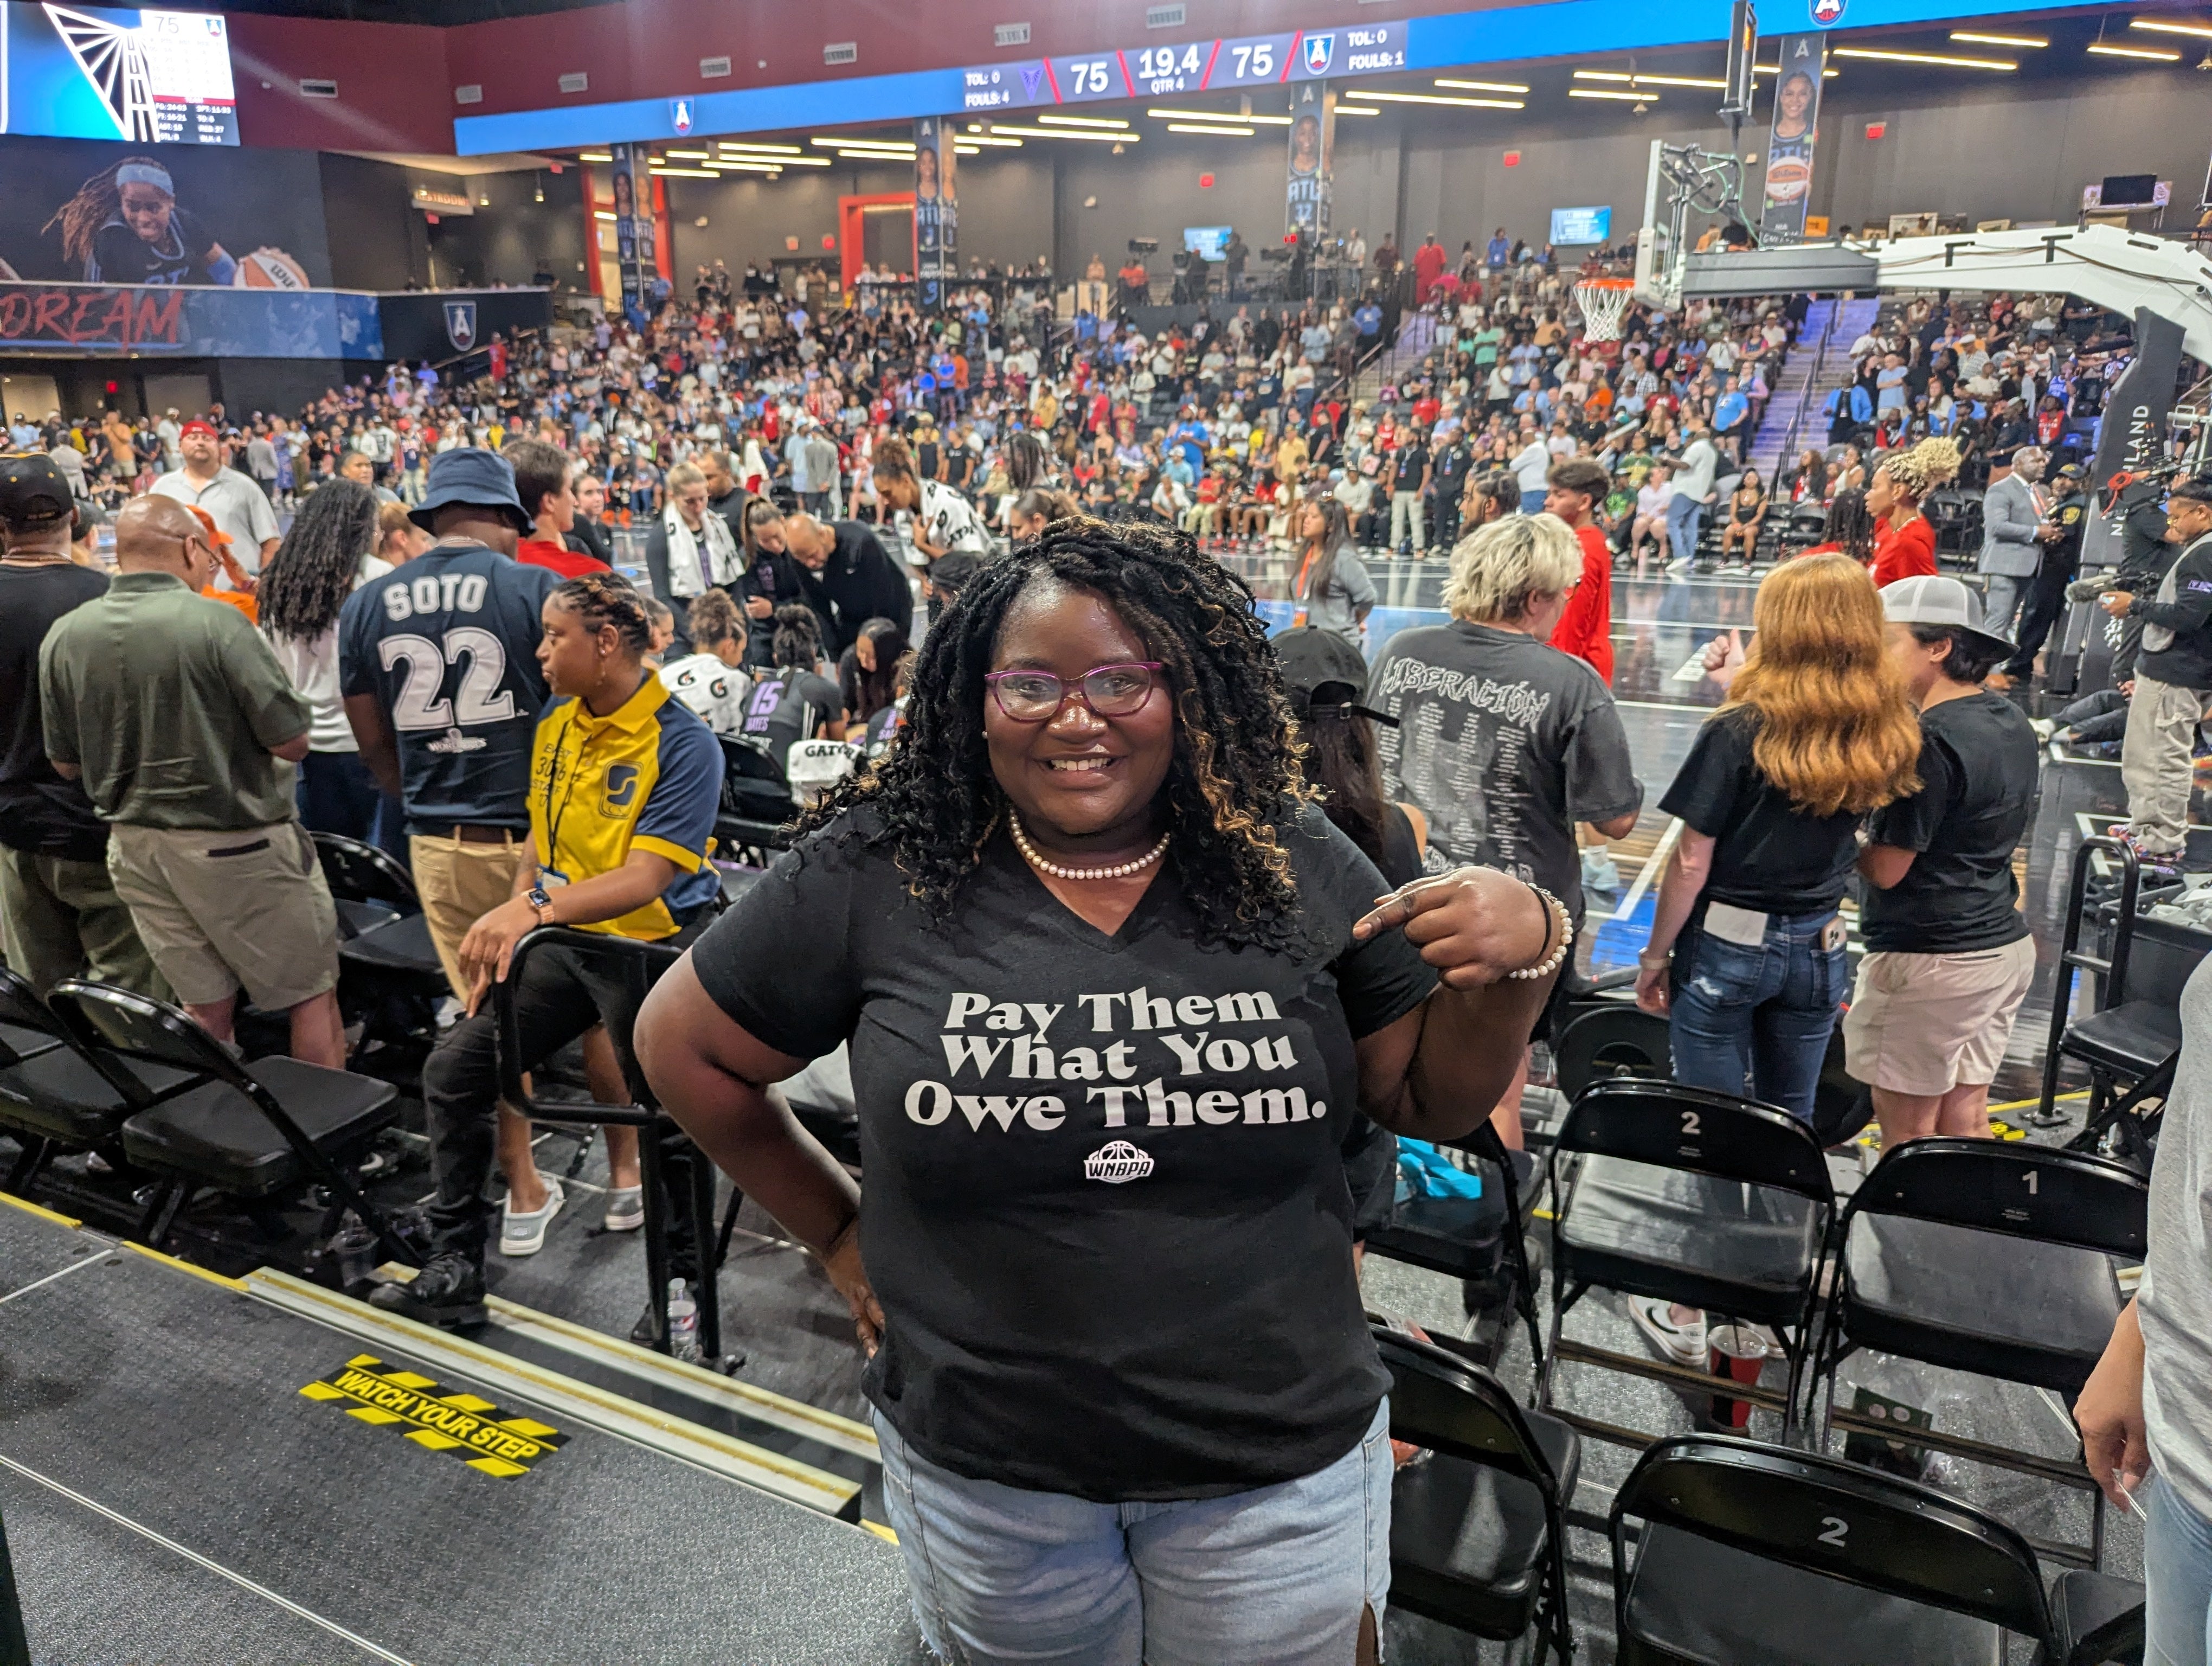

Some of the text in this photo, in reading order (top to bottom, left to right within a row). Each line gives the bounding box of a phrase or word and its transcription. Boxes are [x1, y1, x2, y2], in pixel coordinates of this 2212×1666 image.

[154, 16, 179, 34] 75
[1377, 29, 1387, 44] 0
[991, 69, 1001, 84] 0
[1138, 43, 1201, 80] 19.4
[1232, 43, 1274, 79] 75
[1348, 50, 1405, 71] FOULS: 1
[1070, 61, 1109, 94] 75
[1150, 76, 1186, 95] QTR 4
[1001, 89, 1011, 104] 4
[0, 290, 184, 355] DREAM
[2111, 405, 2149, 536] NLAND
[382, 573, 488, 622] SOTO
[377, 625, 516, 731] 22
[710, 677, 728, 699] G
[749, 681, 785, 716] 15
[536, 757, 567, 781] 306
[531, 779, 563, 795] STAF
[944, 986, 1282, 1043] Pay Them
[940, 1031, 1300, 1080] What You
[904, 1078, 1328, 1133] Owe Them.
[1681, 1111, 1701, 1135] 2
[1088, 1160, 1151, 1177] WNBPA
[2022, 1170, 2038, 1195] 1
[333, 1370, 541, 1460] WATCH YOUR STEP
[1817, 1516, 1849, 1548] 2
